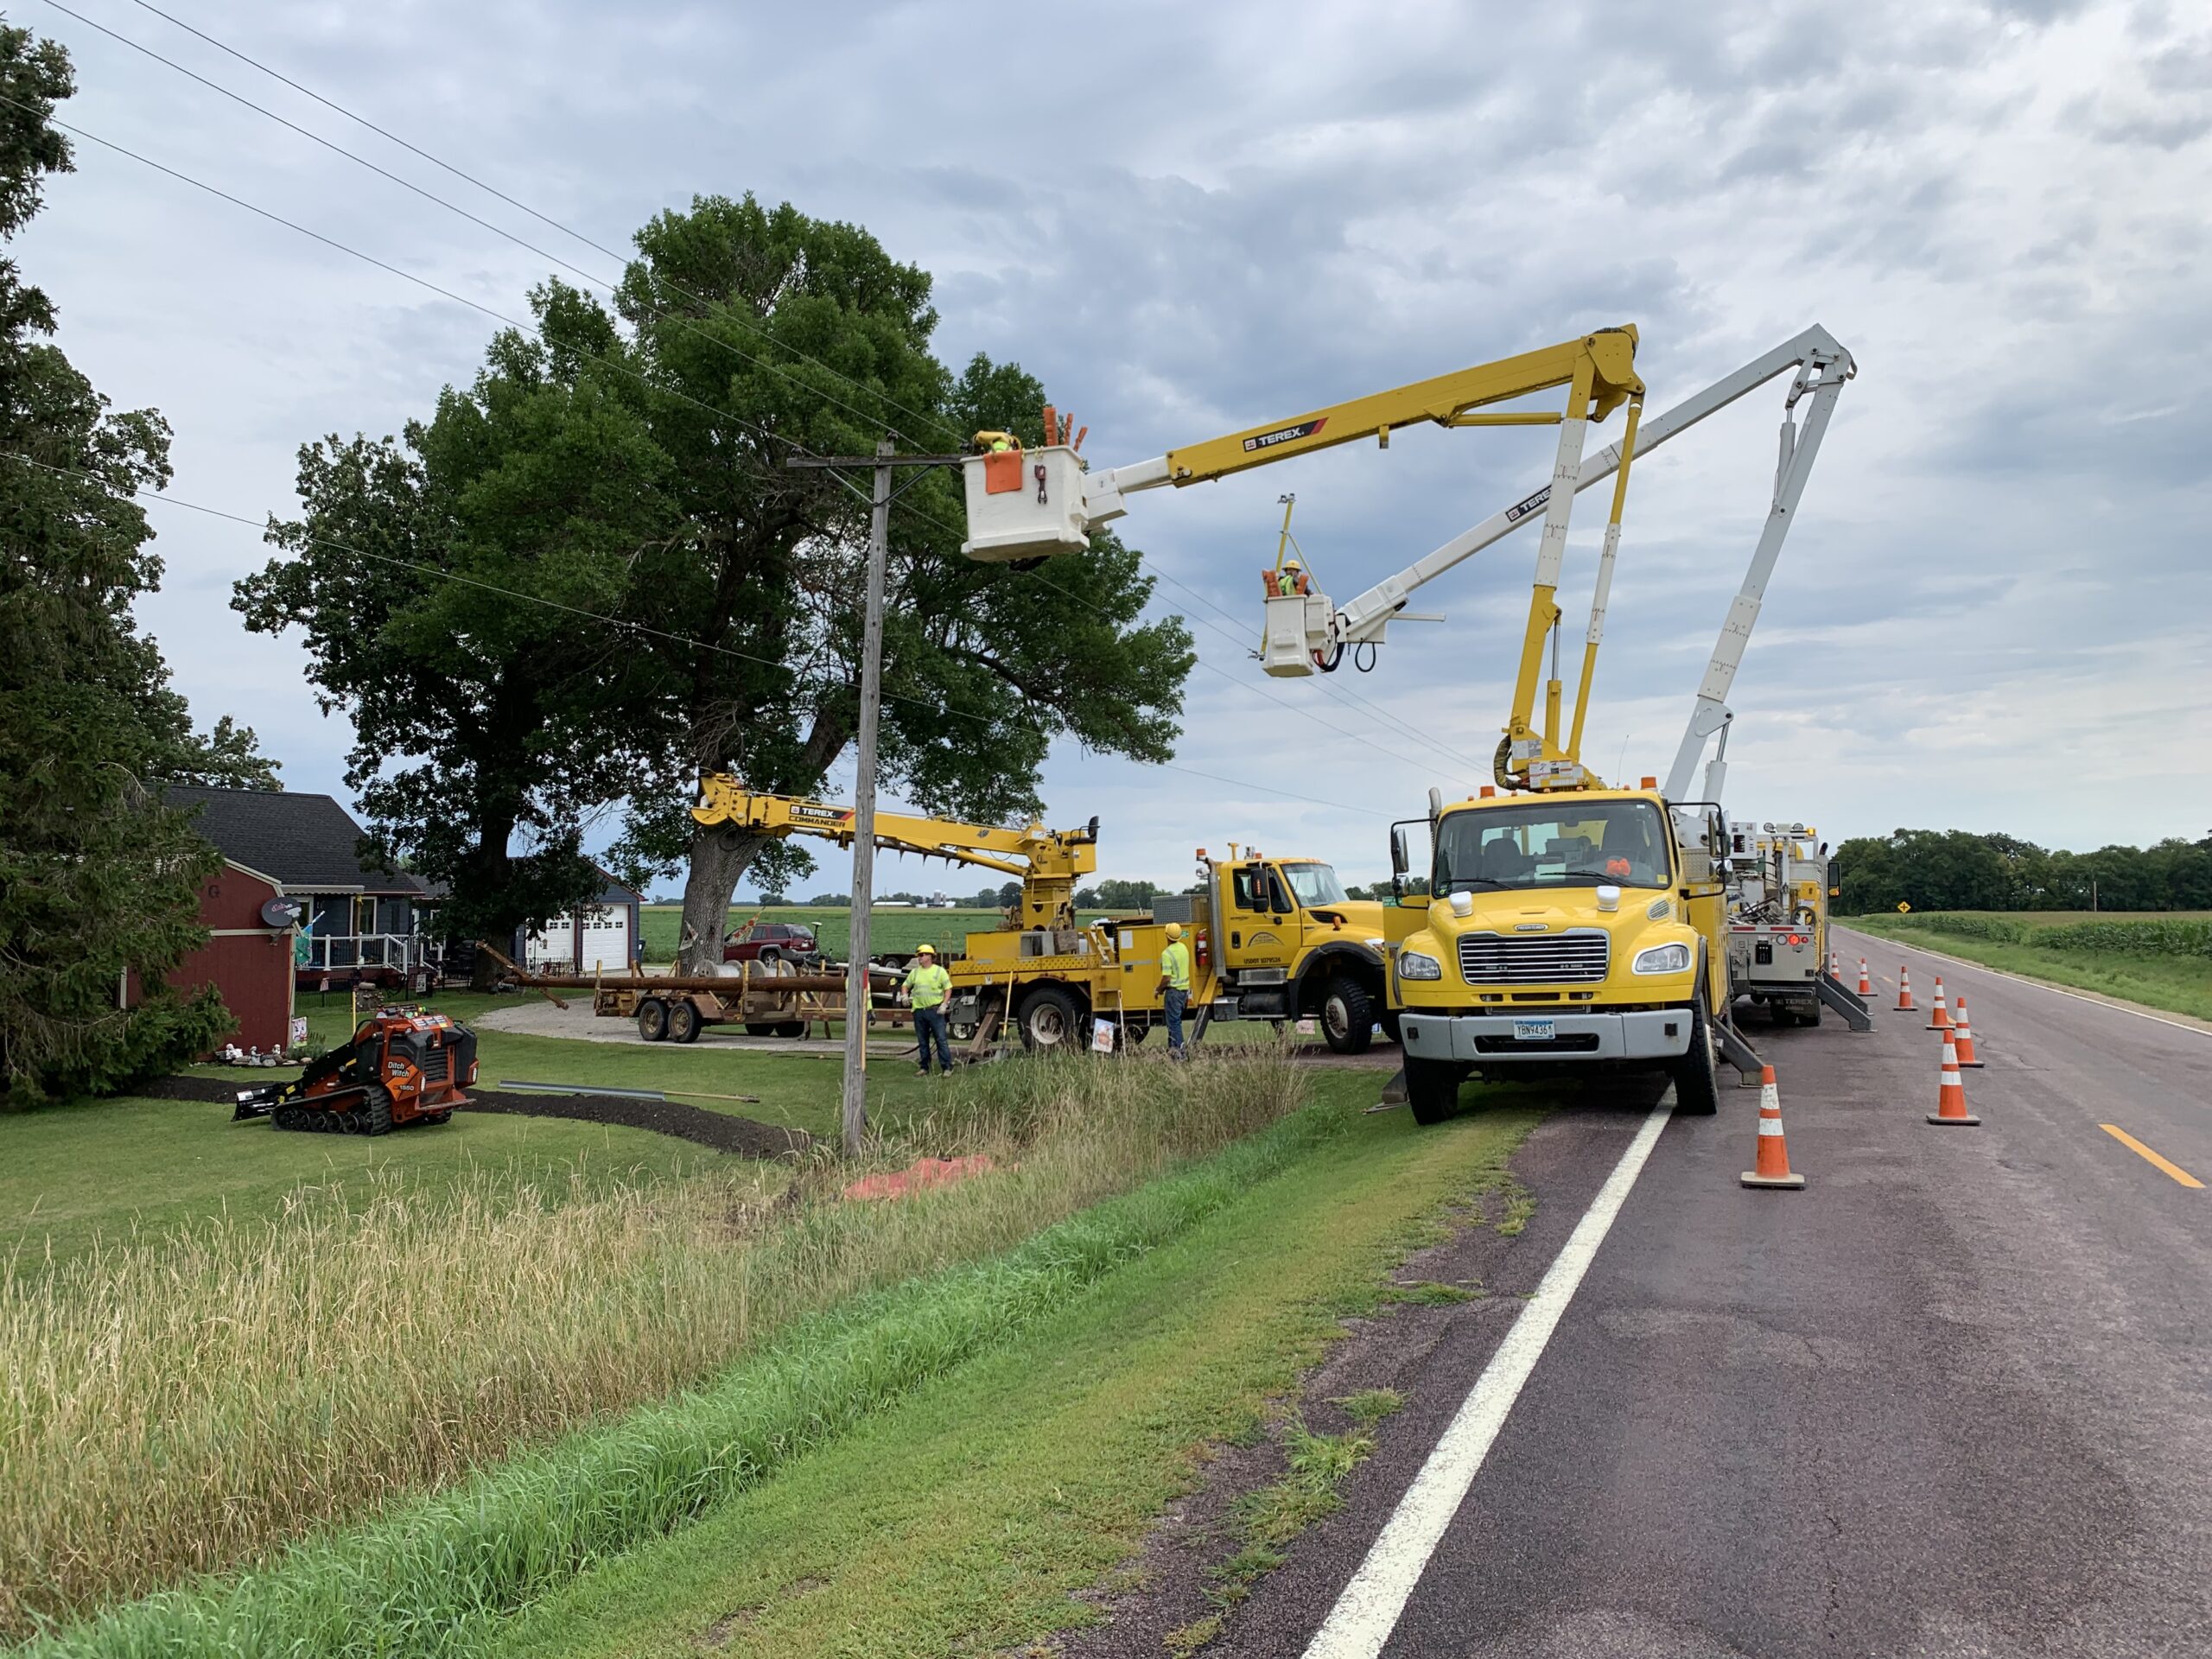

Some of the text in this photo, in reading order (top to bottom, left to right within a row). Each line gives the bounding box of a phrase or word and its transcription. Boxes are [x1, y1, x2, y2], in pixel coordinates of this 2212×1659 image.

[1259, 427, 1301, 446] TEREX
[1520, 489, 1551, 512] TERE
[802, 807, 834, 817] TEREX
[789, 816, 846, 828] COMMANDER
[388, 1061, 404, 1070] Ditch
